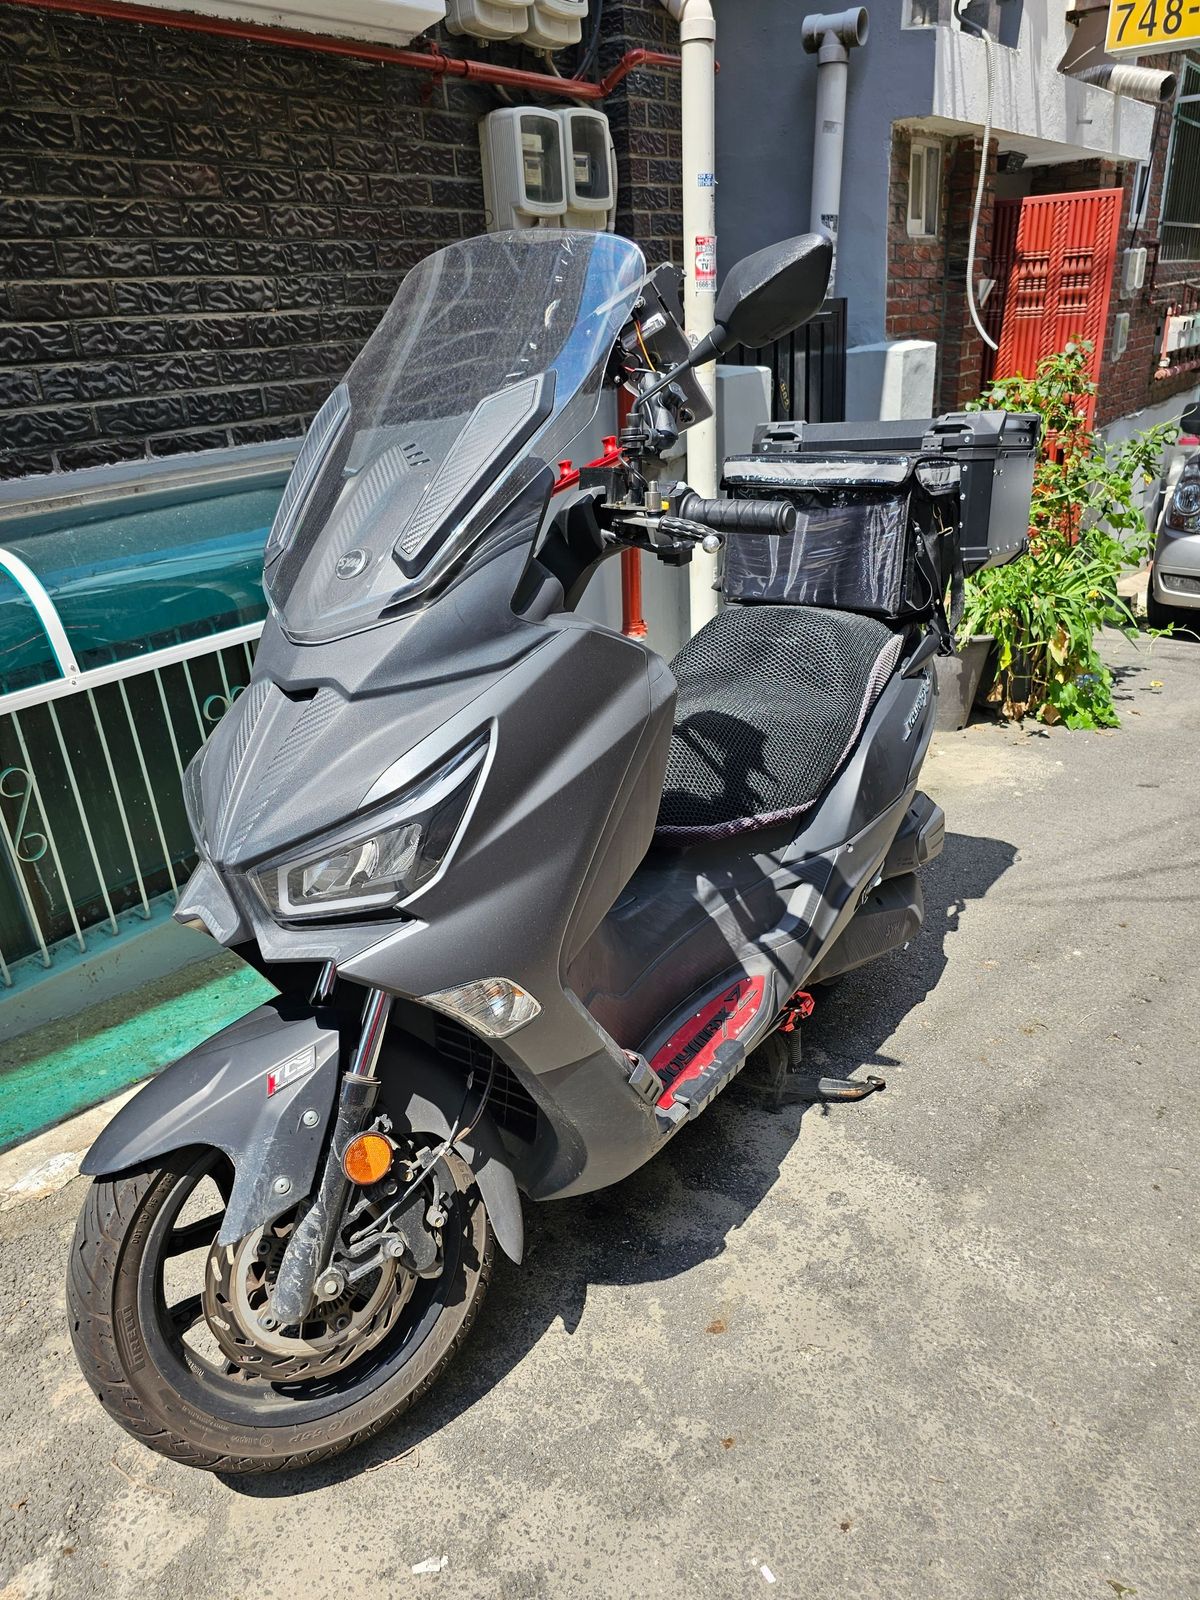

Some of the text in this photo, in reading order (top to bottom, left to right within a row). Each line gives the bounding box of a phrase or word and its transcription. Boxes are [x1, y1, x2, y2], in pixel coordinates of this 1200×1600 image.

[1116, 0, 1200, 42] 748-
[338, 557, 362, 570] SYM
[270, 1047, 313, 1086] TCS
[116, 1304, 146, 1375] PIRELLI
